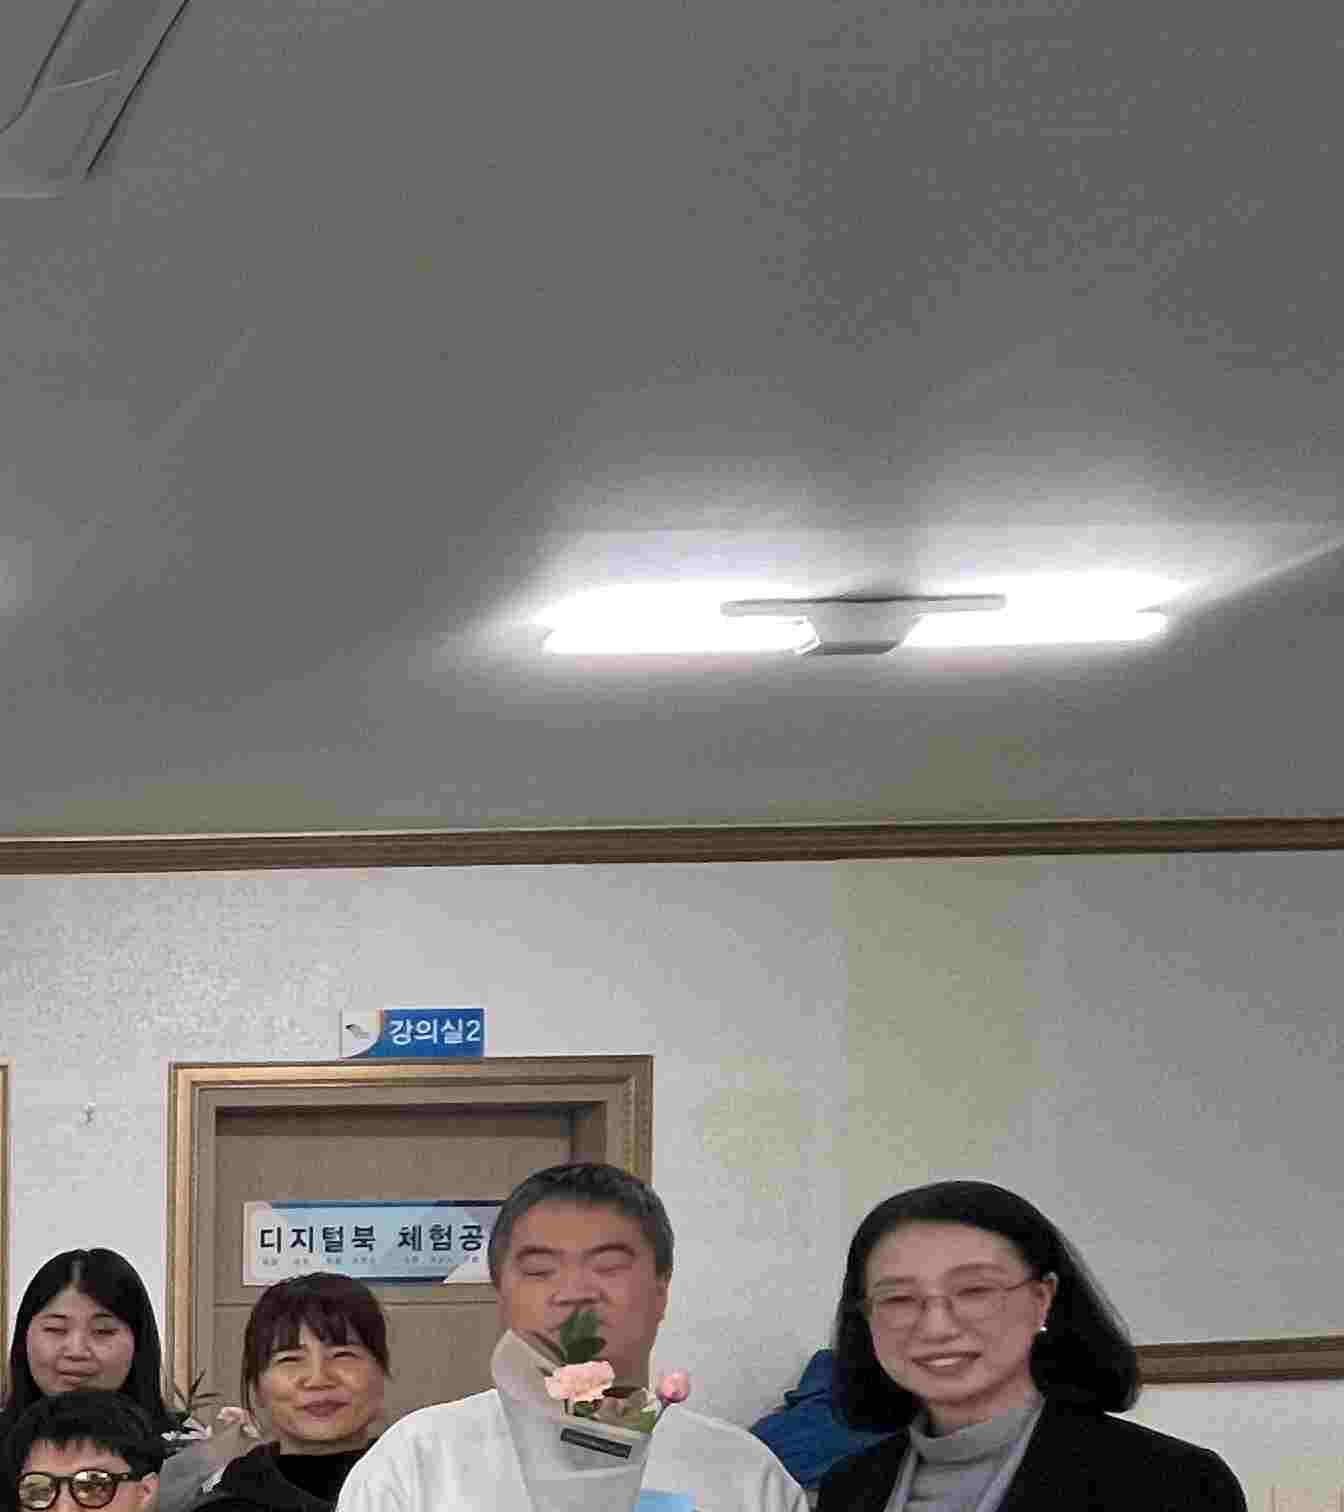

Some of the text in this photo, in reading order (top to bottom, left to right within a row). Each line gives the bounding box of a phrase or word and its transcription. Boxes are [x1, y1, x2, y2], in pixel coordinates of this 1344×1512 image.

[389, 1018, 482, 1046] 강의실2
[260, 1224, 484, 1254] 디지털북 체험공
